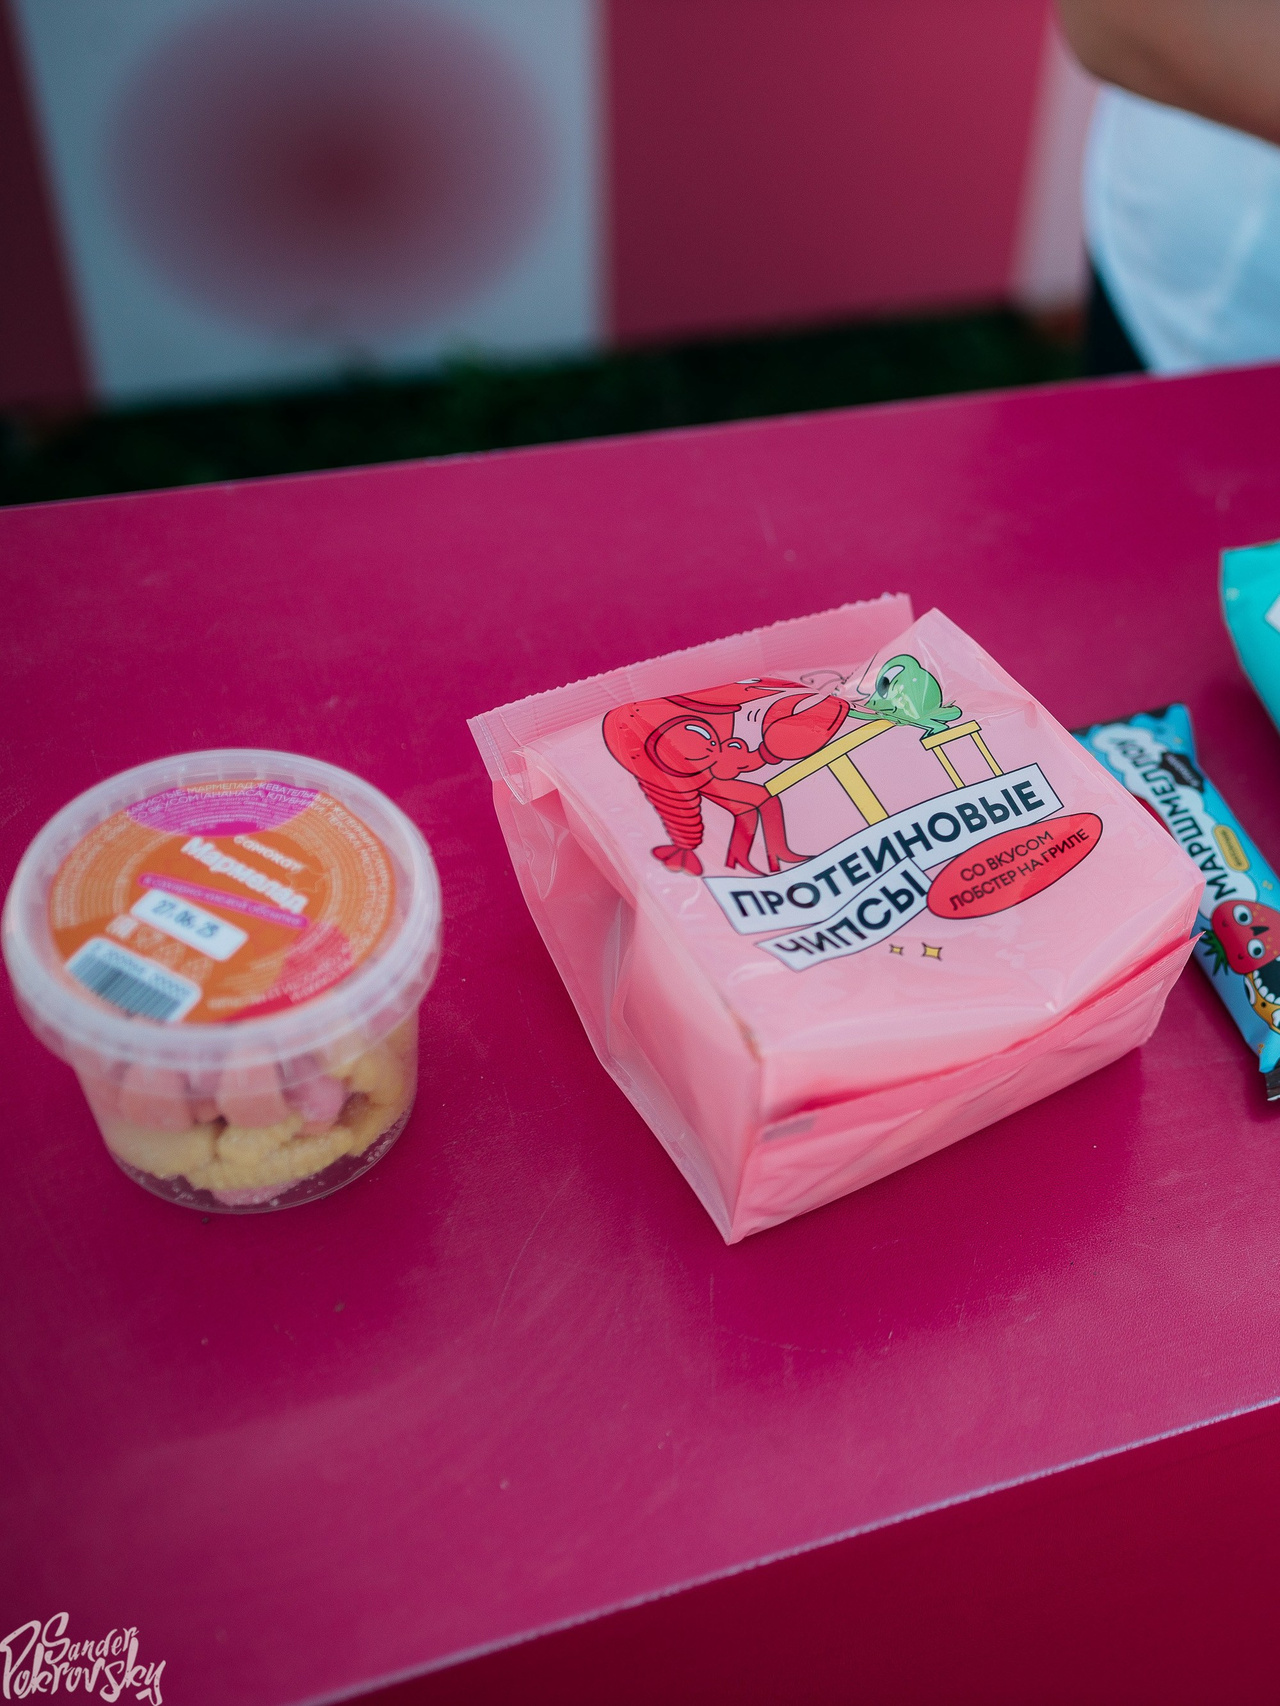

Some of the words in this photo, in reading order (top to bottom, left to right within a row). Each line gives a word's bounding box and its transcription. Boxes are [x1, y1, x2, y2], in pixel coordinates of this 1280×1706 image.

[730, 780, 1045, 918] ПРОТЕИНОВЫЕ
[949, 869, 1018, 912] ЛОБСТЕР
[1019, 857, 1044, 878] НА
[1040, 827, 1091, 865] ГРИЛЕ
[960, 863, 987, 883] СО
[986, 830, 1055, 871] ВКУСОМ
[774, 869, 928, 957] ЧИПСЫ
